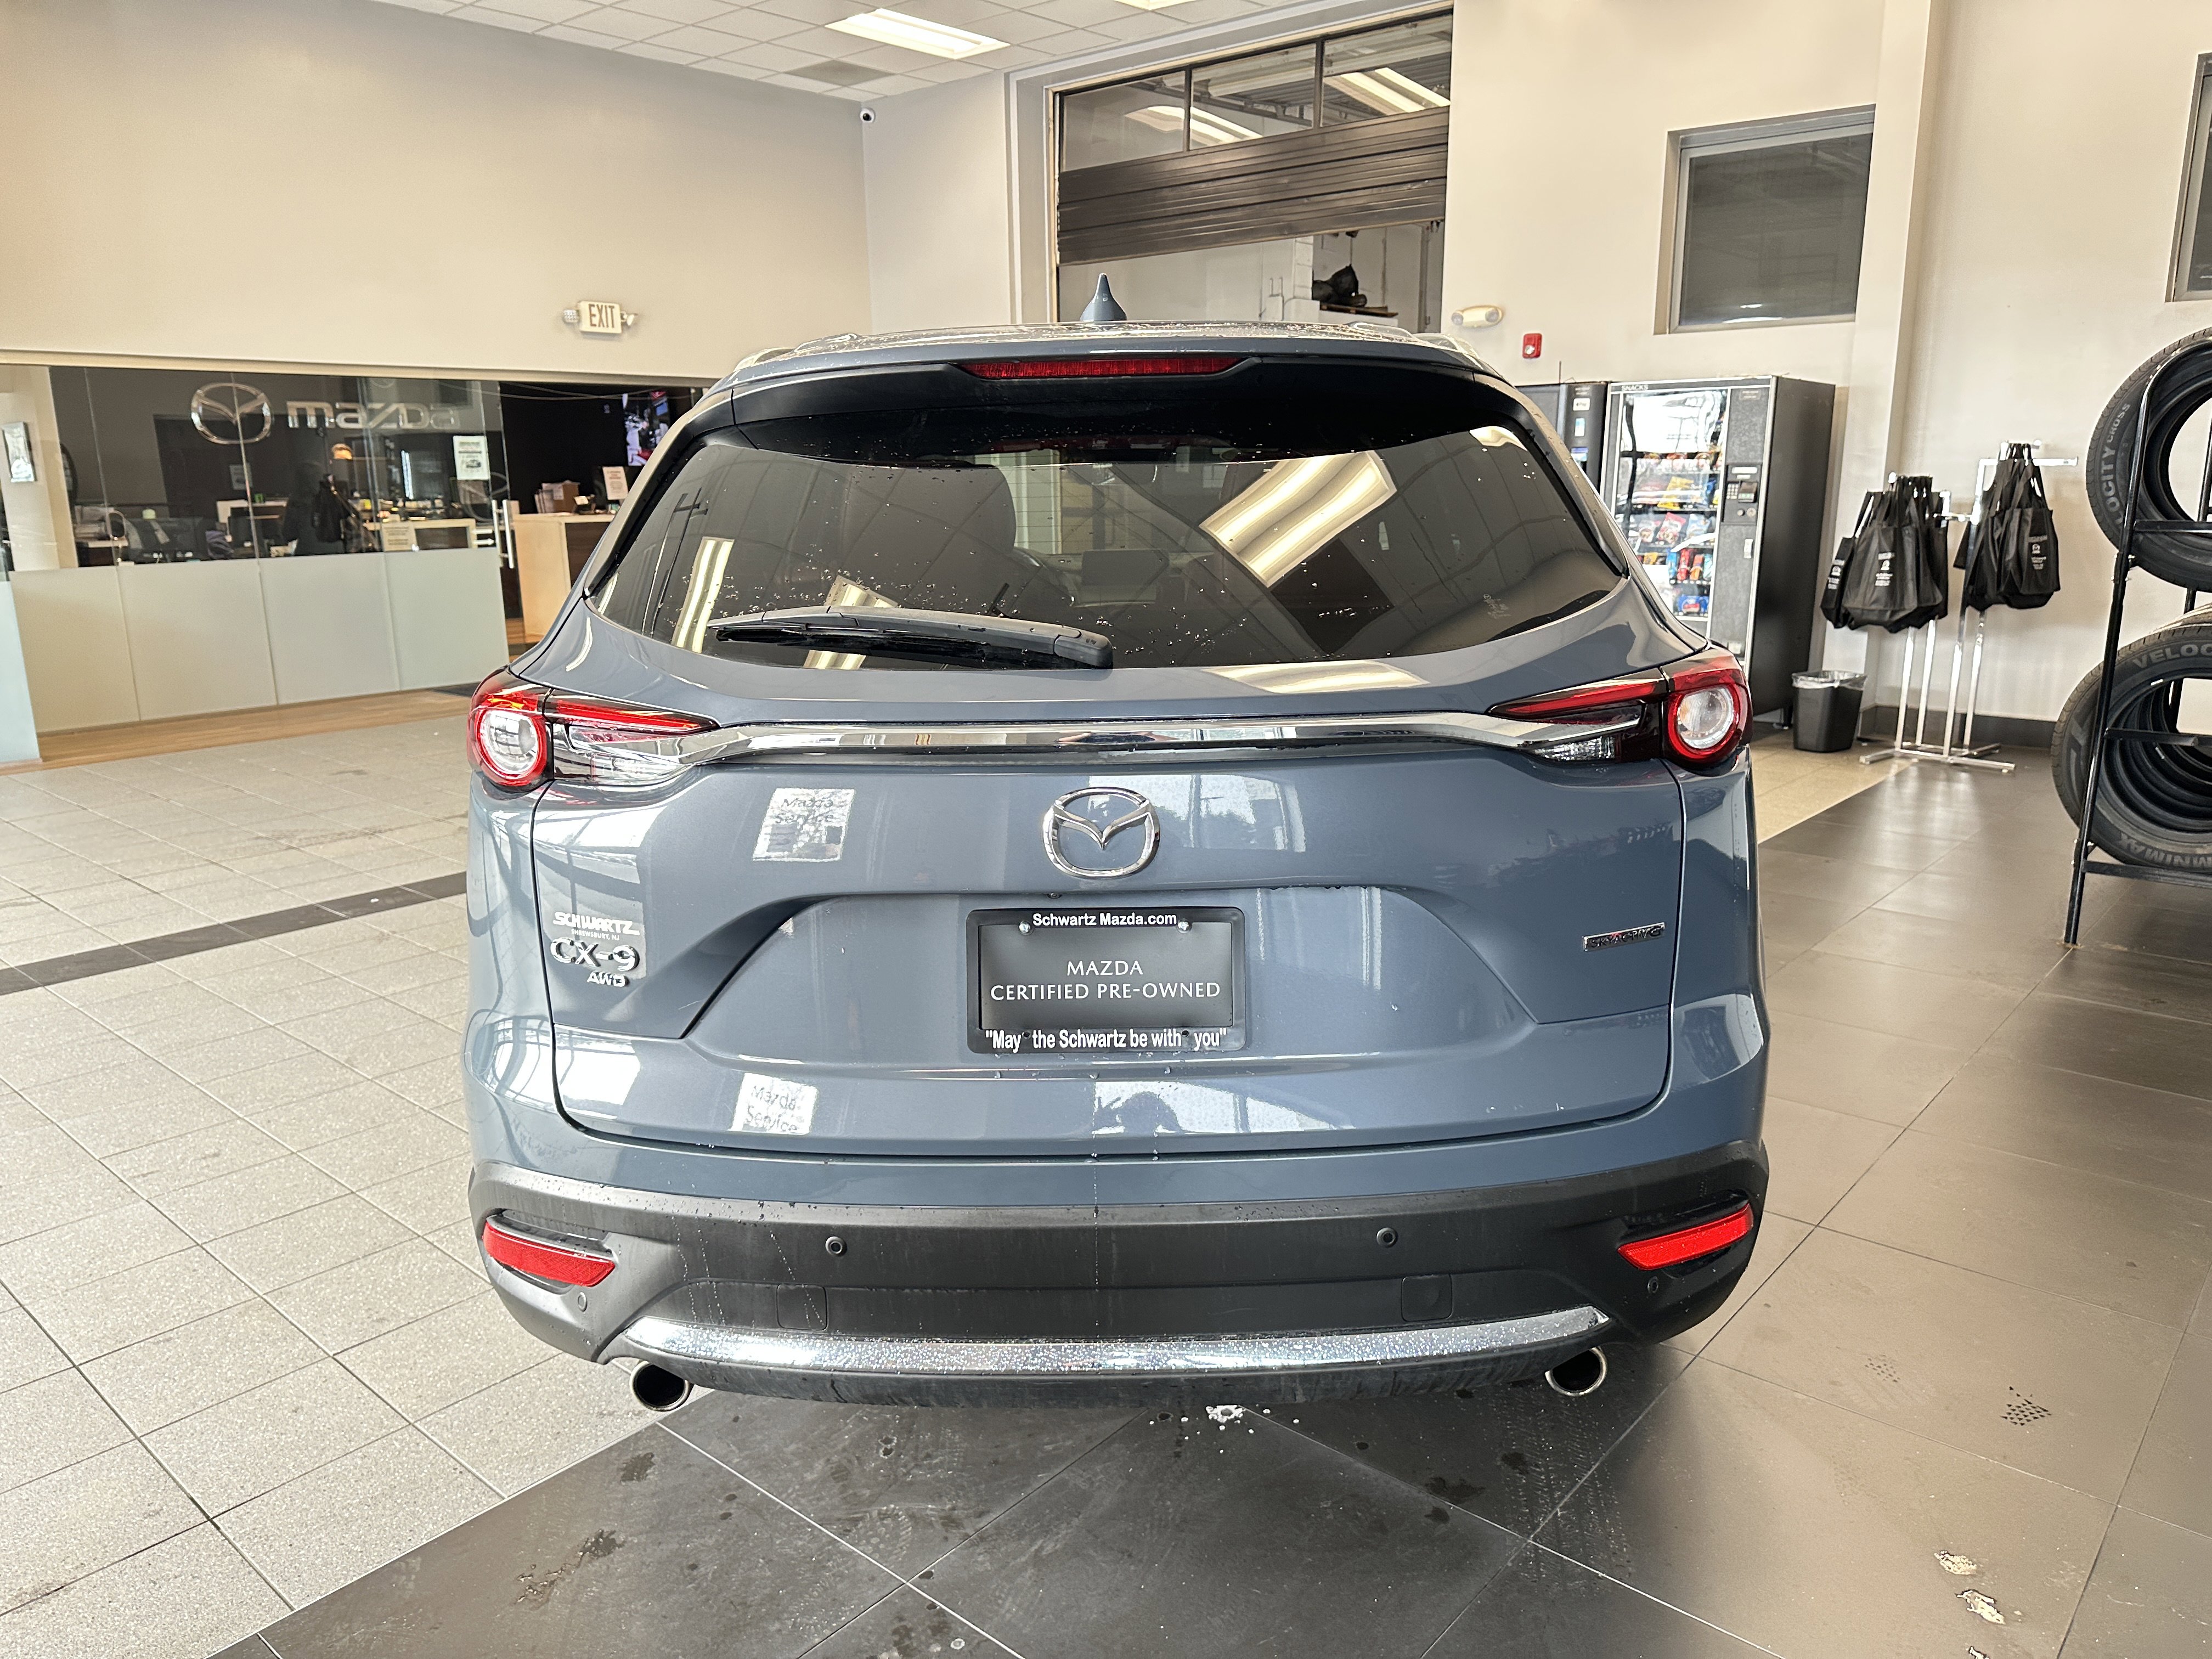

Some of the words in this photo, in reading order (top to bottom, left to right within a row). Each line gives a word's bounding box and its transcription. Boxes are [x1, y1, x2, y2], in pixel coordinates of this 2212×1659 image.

[588, 303, 615, 329] EXIT
[2106, 403, 2131, 443] CROSS
[553, 911, 640, 935] SCHWARTZ
[1032, 913, 1097, 926] Schwartz
[1099, 912, 1177, 926] Mazda.com
[550, 937, 640, 972] CX-9
[587, 970, 630, 987] AWD
[1066, 960, 1143, 976] MAZDA
[990, 984, 1089, 1001] CERTIFIED
[1097, 981, 1221, 999] PRE-OWNED
[985, 1029, 1022, 1053] "May
[1032, 1029, 1056, 1048] the
[1059, 1028, 1127, 1048] Schwartz
[1130, 1028, 1148, 1047] be
[1152, 1029, 1182, 1047] with
[1194, 1027, 1227, 1051] you"
